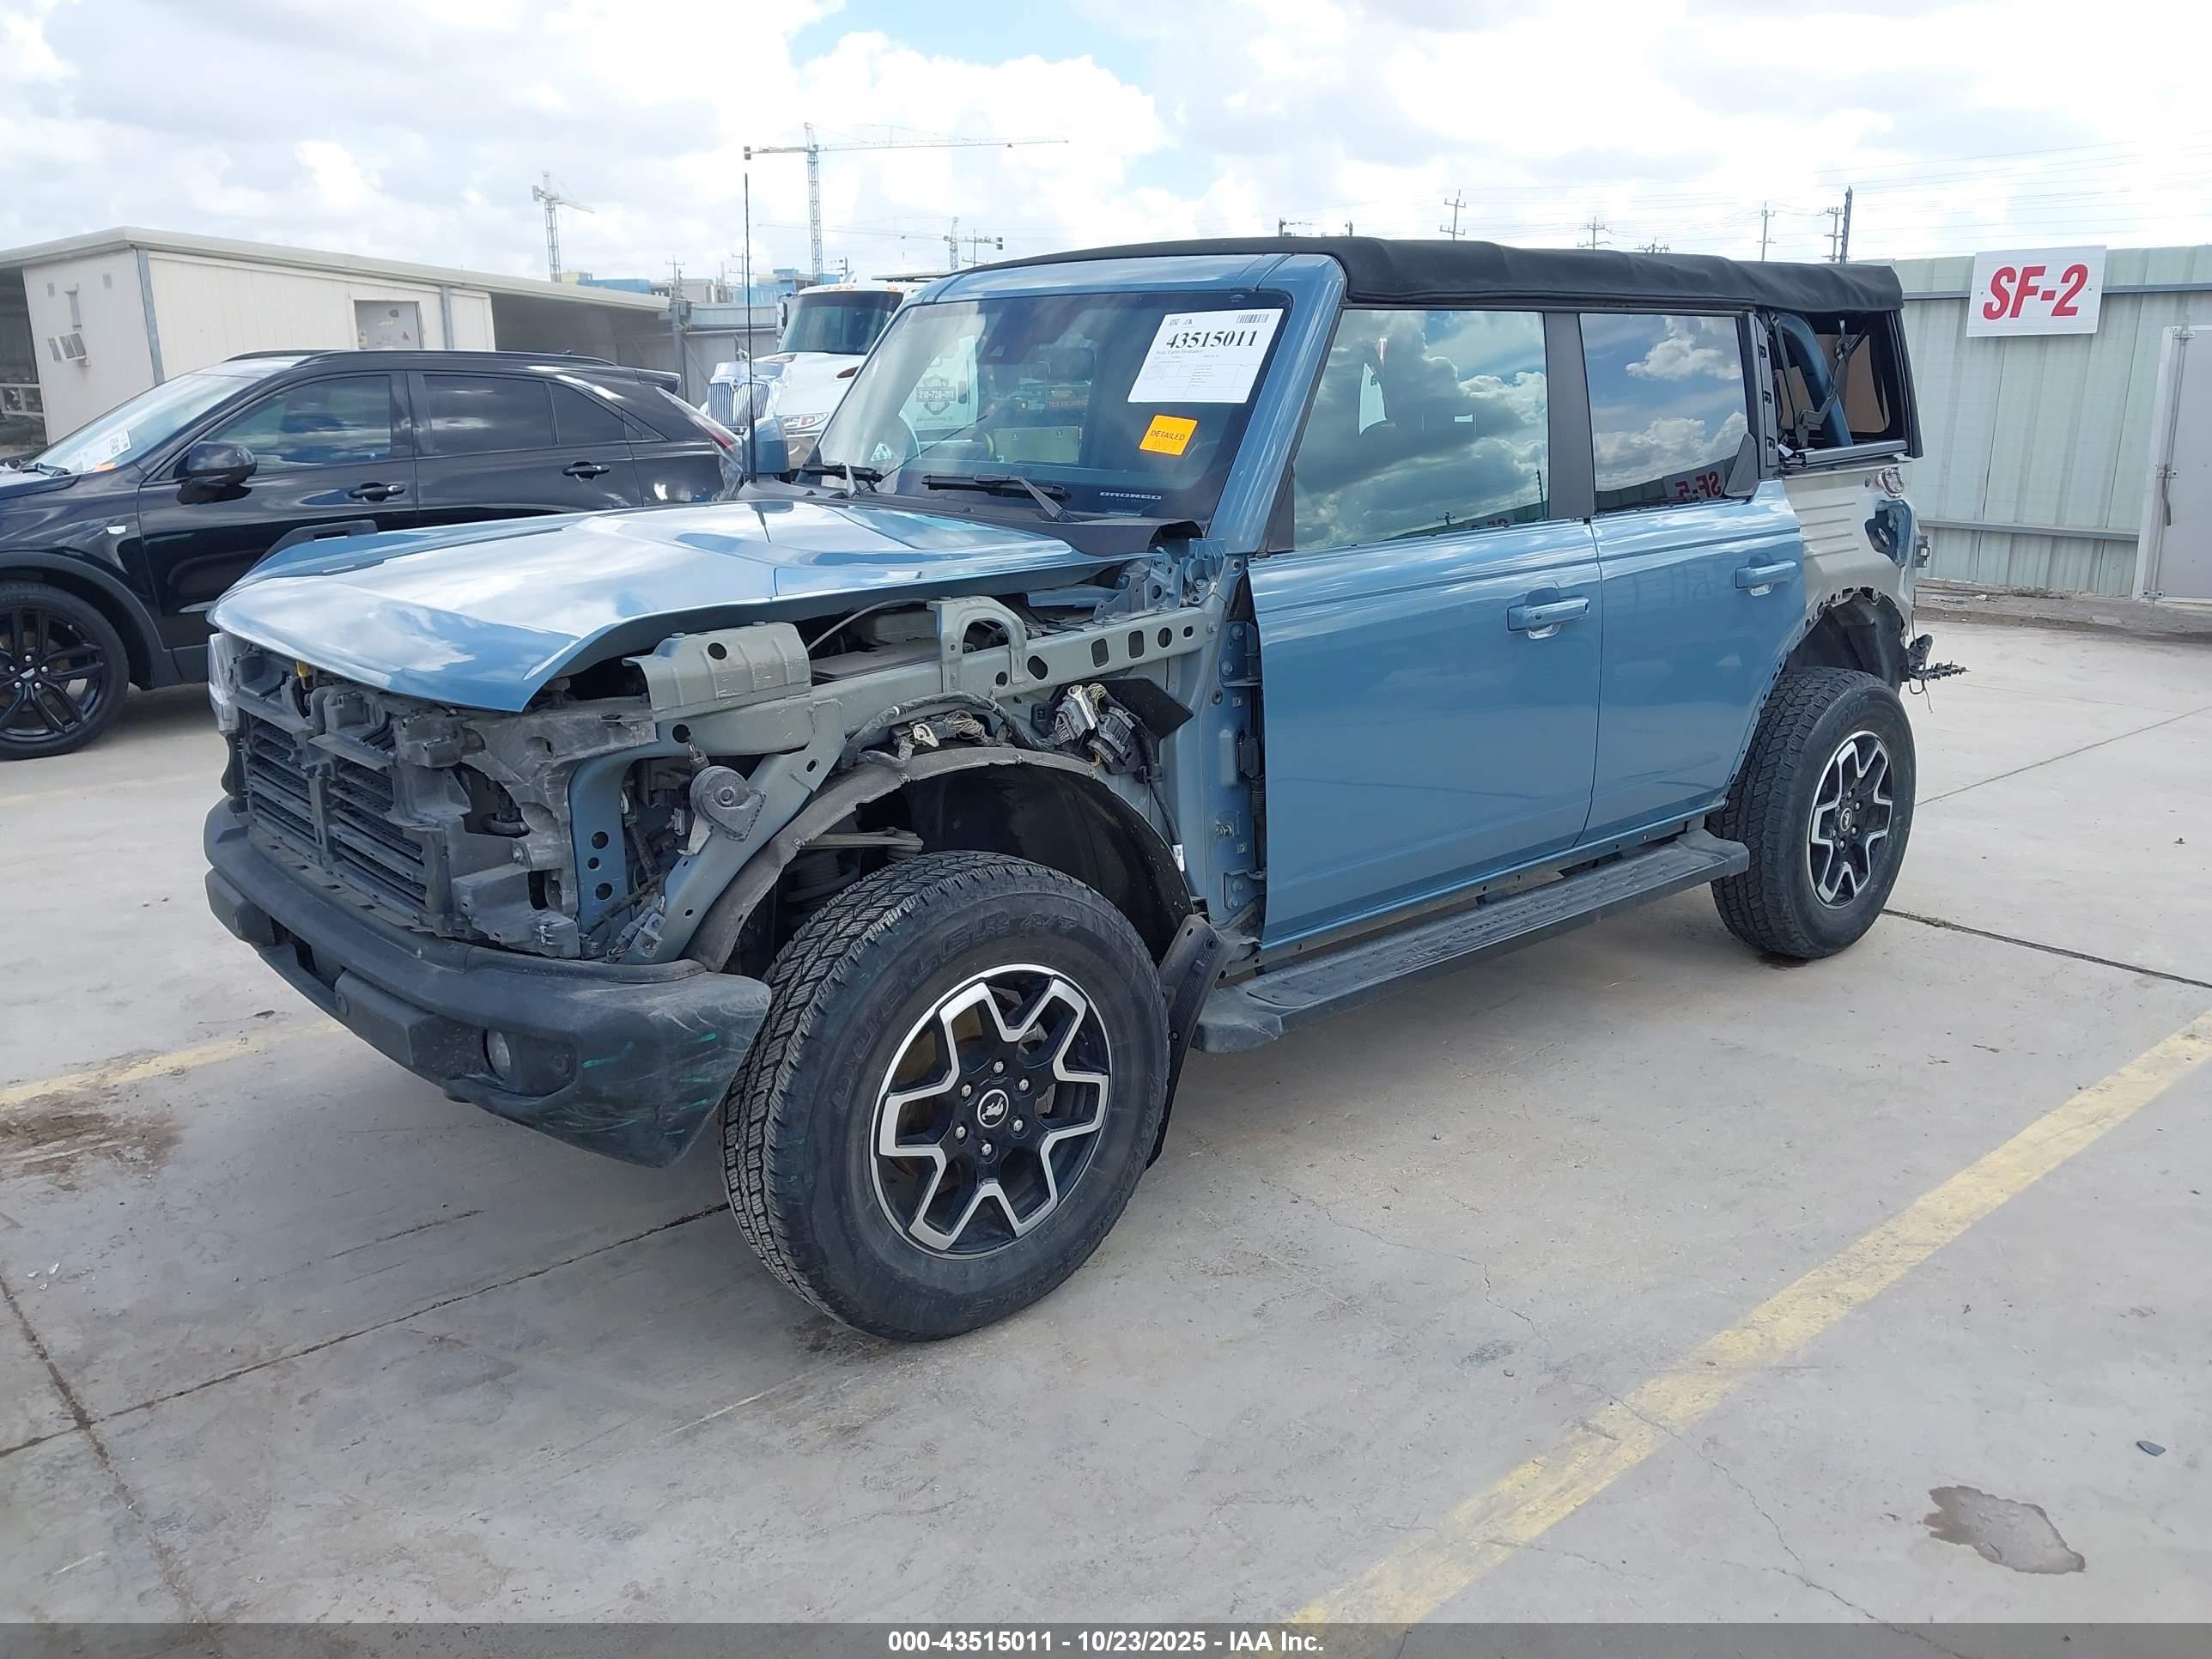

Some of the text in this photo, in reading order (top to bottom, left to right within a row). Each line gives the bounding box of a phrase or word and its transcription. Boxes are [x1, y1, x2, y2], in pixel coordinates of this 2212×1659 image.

[1983, 264, 2089, 320] SF-2
[1166, 330, 1258, 349] 43515011
[1151, 429, 1185, 441] DETAILED
[1099, 491, 1162, 500] BRONCO
[830, 911, 1011, 1110] DUELER
